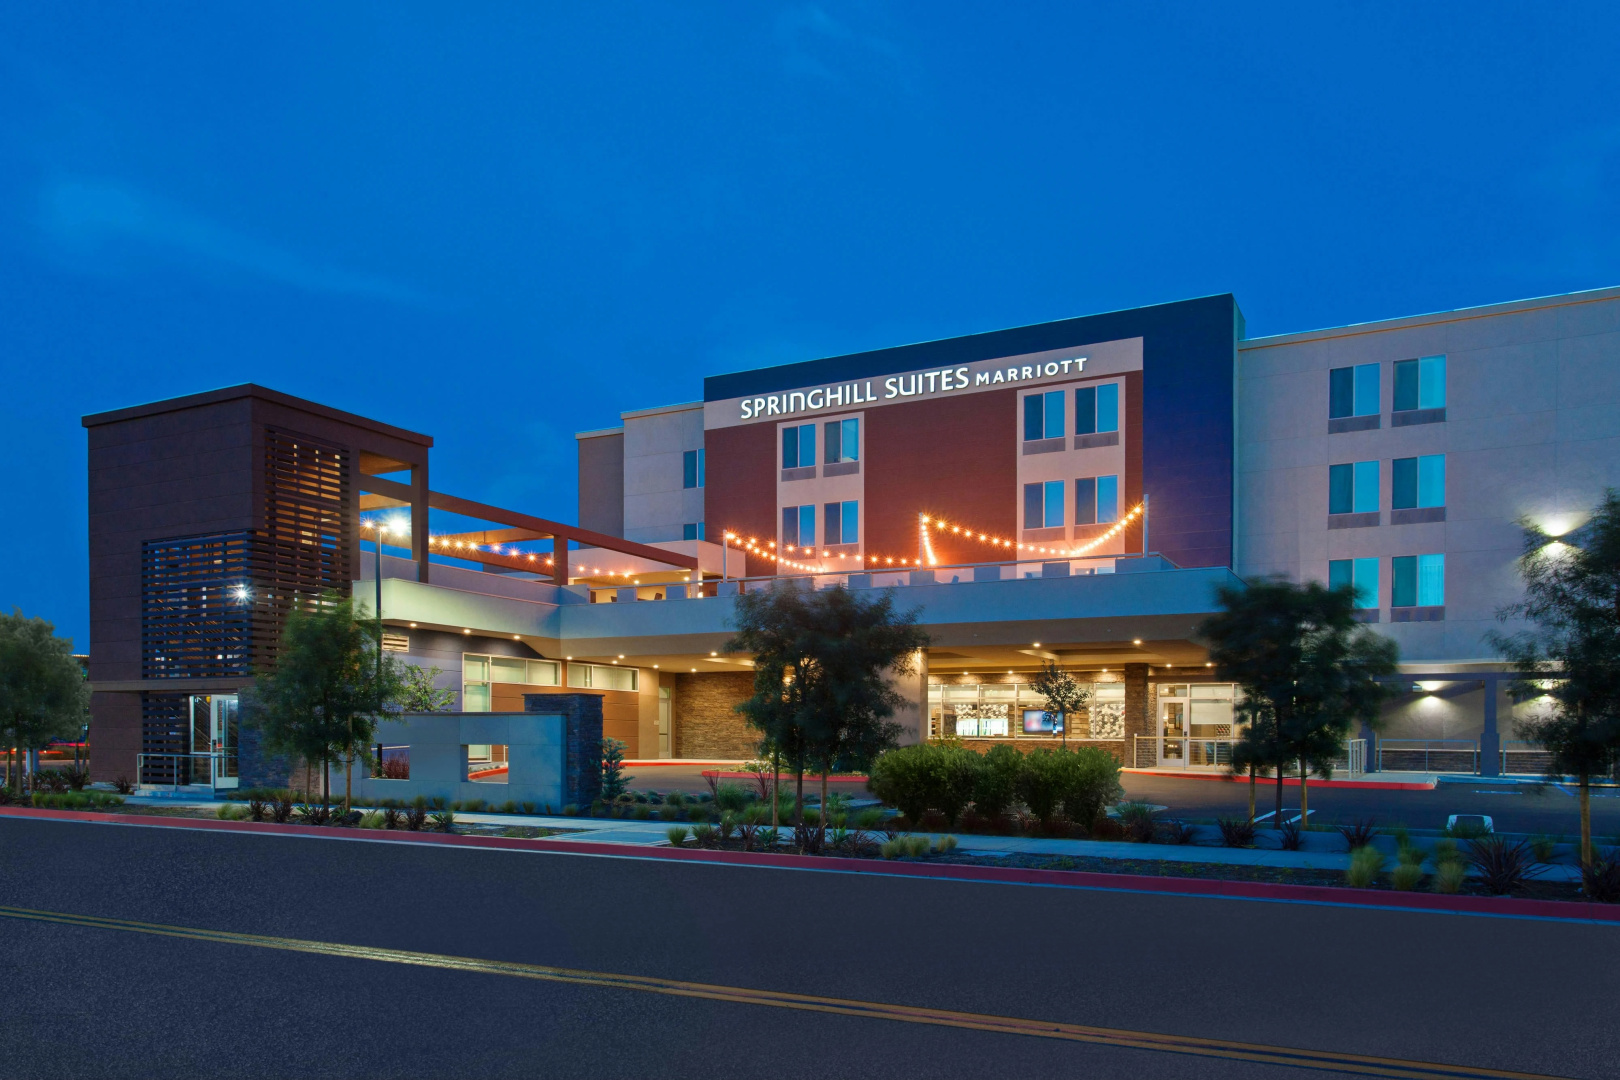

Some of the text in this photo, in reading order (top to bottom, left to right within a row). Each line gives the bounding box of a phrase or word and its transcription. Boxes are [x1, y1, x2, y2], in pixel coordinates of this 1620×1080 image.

[740, 357, 1088, 419] SPRINGHILL SUITES MARRIOTT
